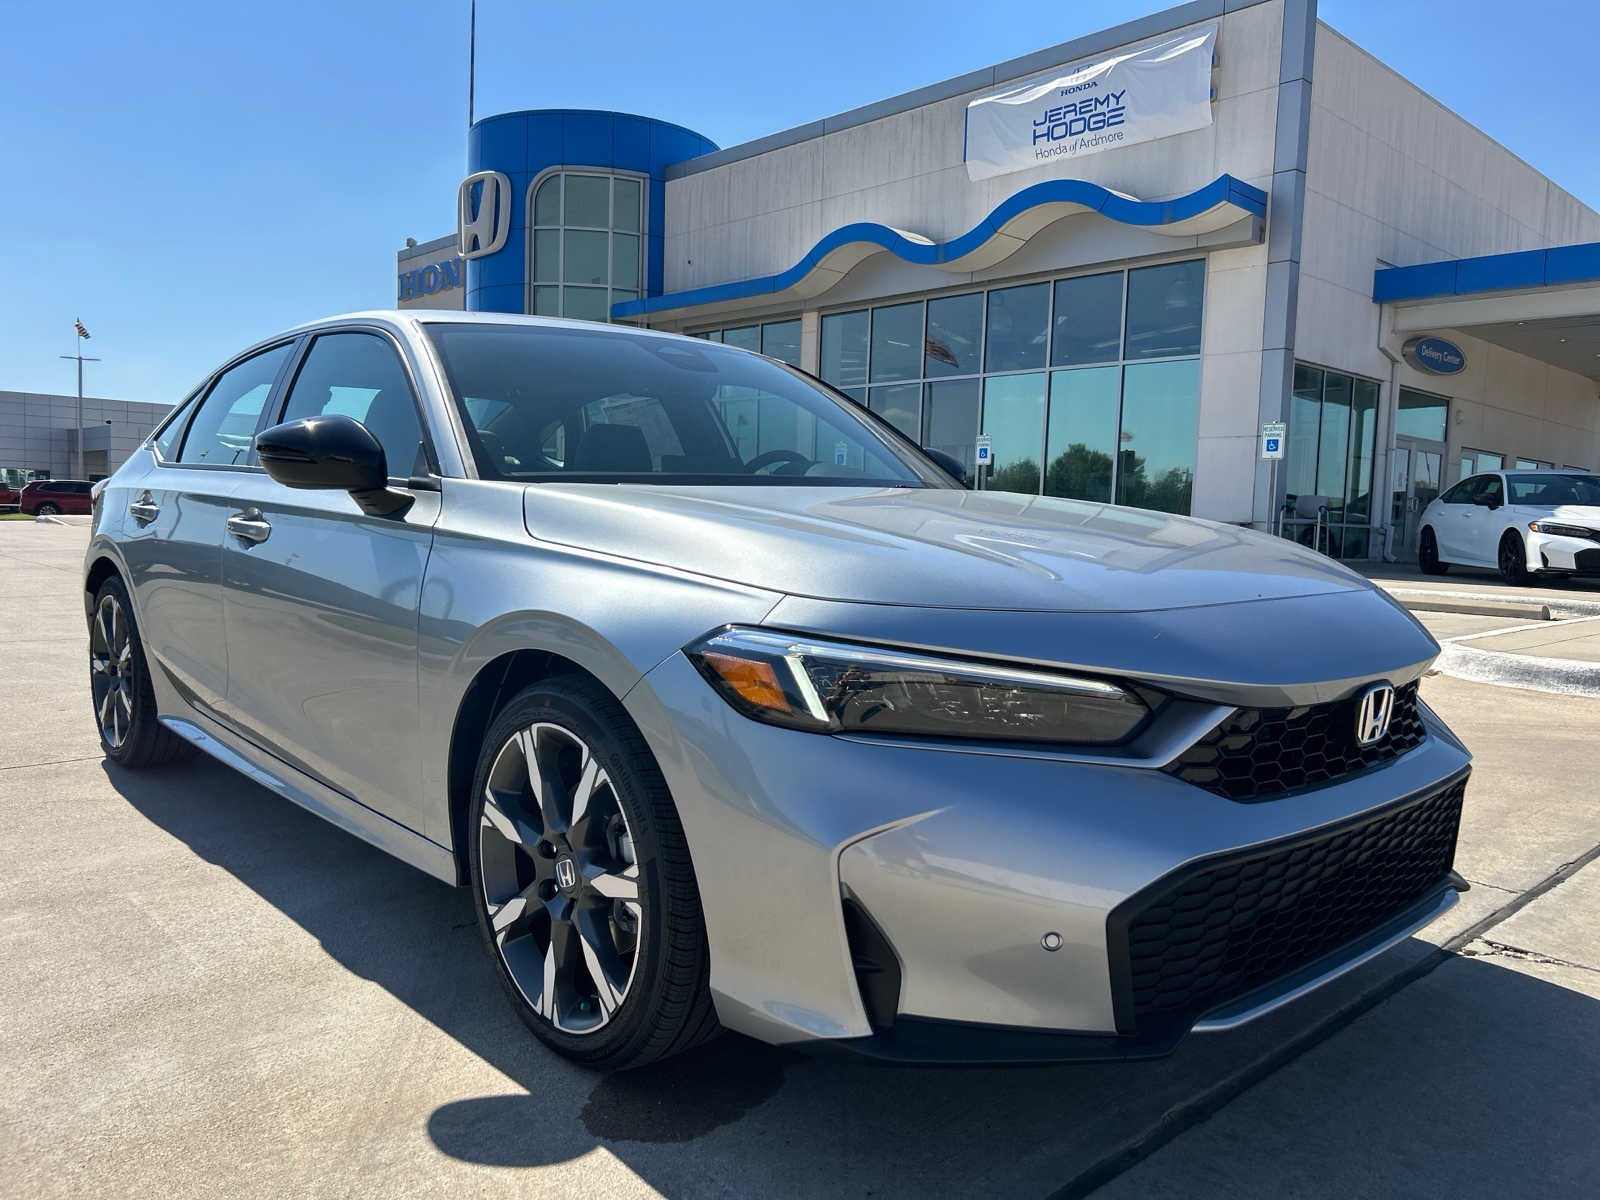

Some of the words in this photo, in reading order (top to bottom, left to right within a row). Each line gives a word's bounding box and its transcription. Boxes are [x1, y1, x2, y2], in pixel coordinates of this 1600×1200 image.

[1060, 81, 1098, 97] HONDA
[1033, 89, 1126, 127] JEREMY
[1032, 106, 1126, 146] HODGE
[1035, 143, 1067, 160] Honda
[1068, 137, 1079, 154] of
[1079, 130, 1124, 150] Ardmore
